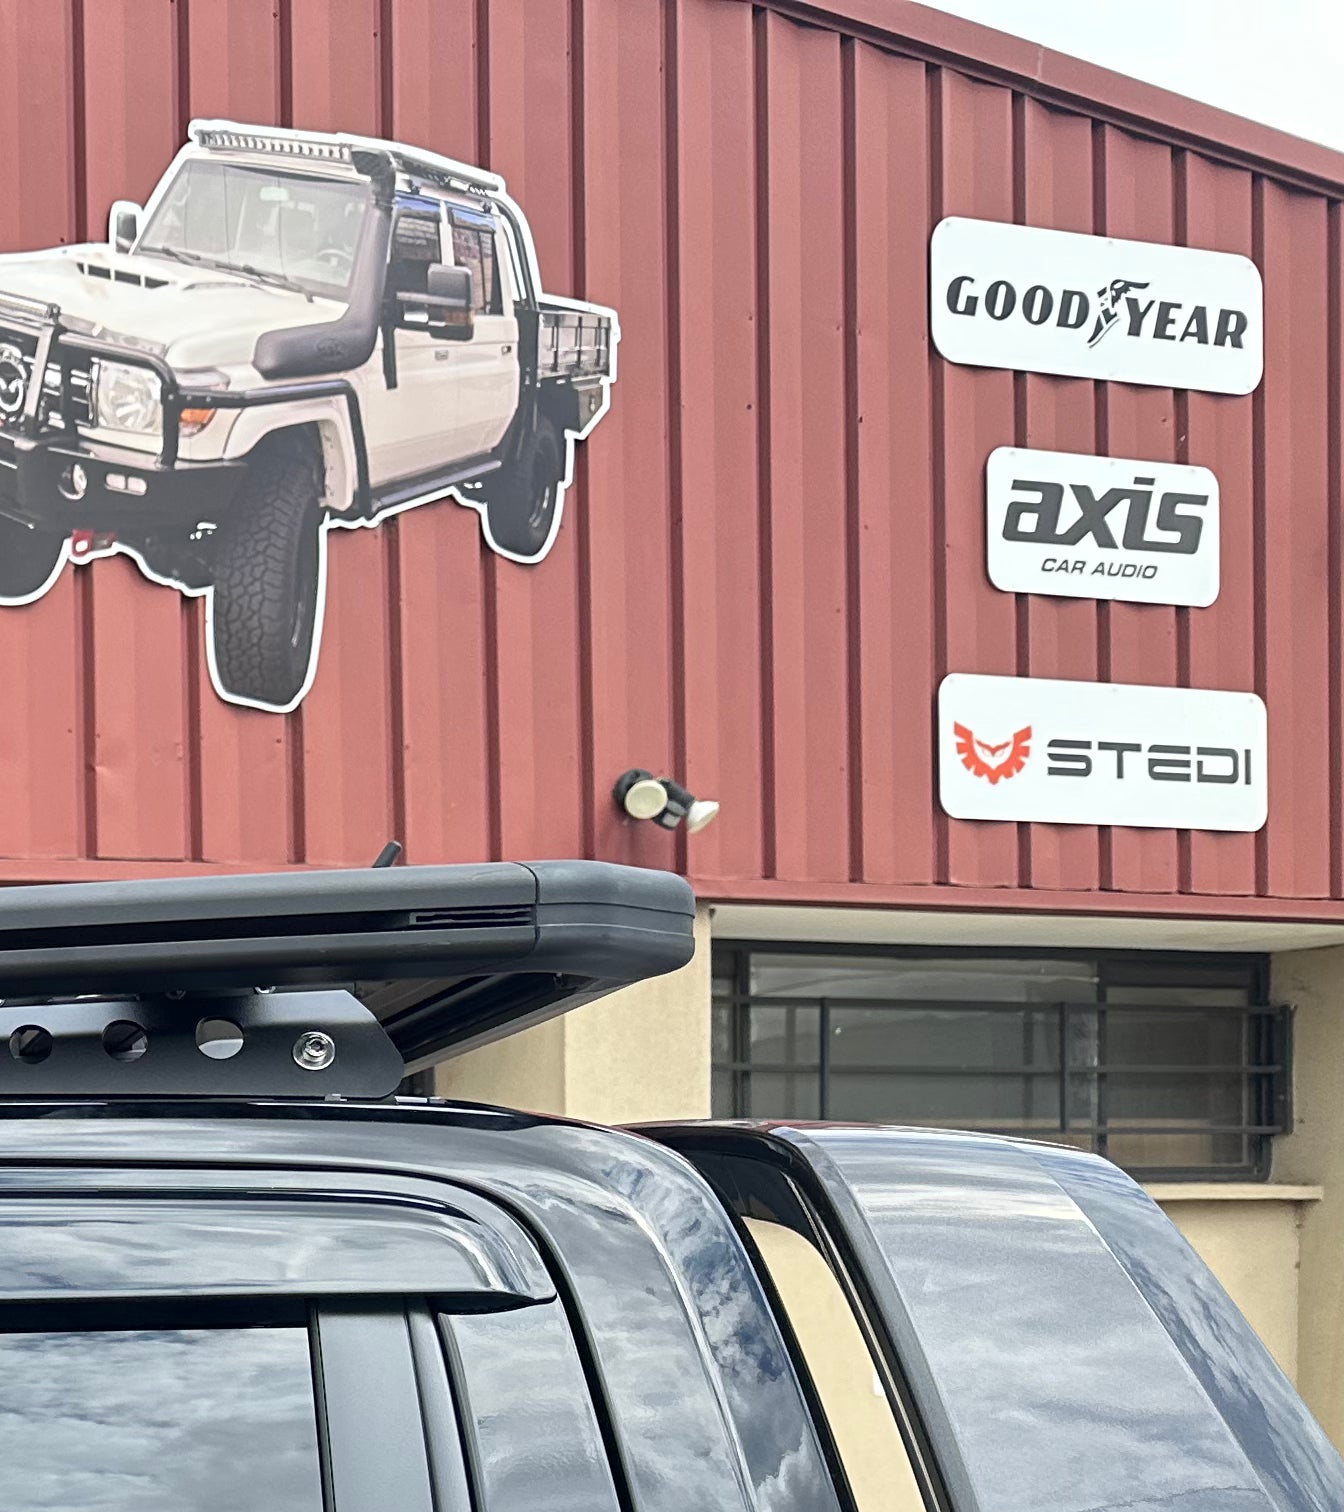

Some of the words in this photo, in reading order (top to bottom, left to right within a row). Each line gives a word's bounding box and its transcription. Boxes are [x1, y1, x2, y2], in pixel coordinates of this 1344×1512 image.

[946, 275, 1249, 349] GOODYEAR
[1002, 476, 1210, 555] axis
[1040, 557, 1087, 574] CAR
[1091, 562, 1159, 580] AUDIO
[1047, 738, 1252, 786] STEDI
